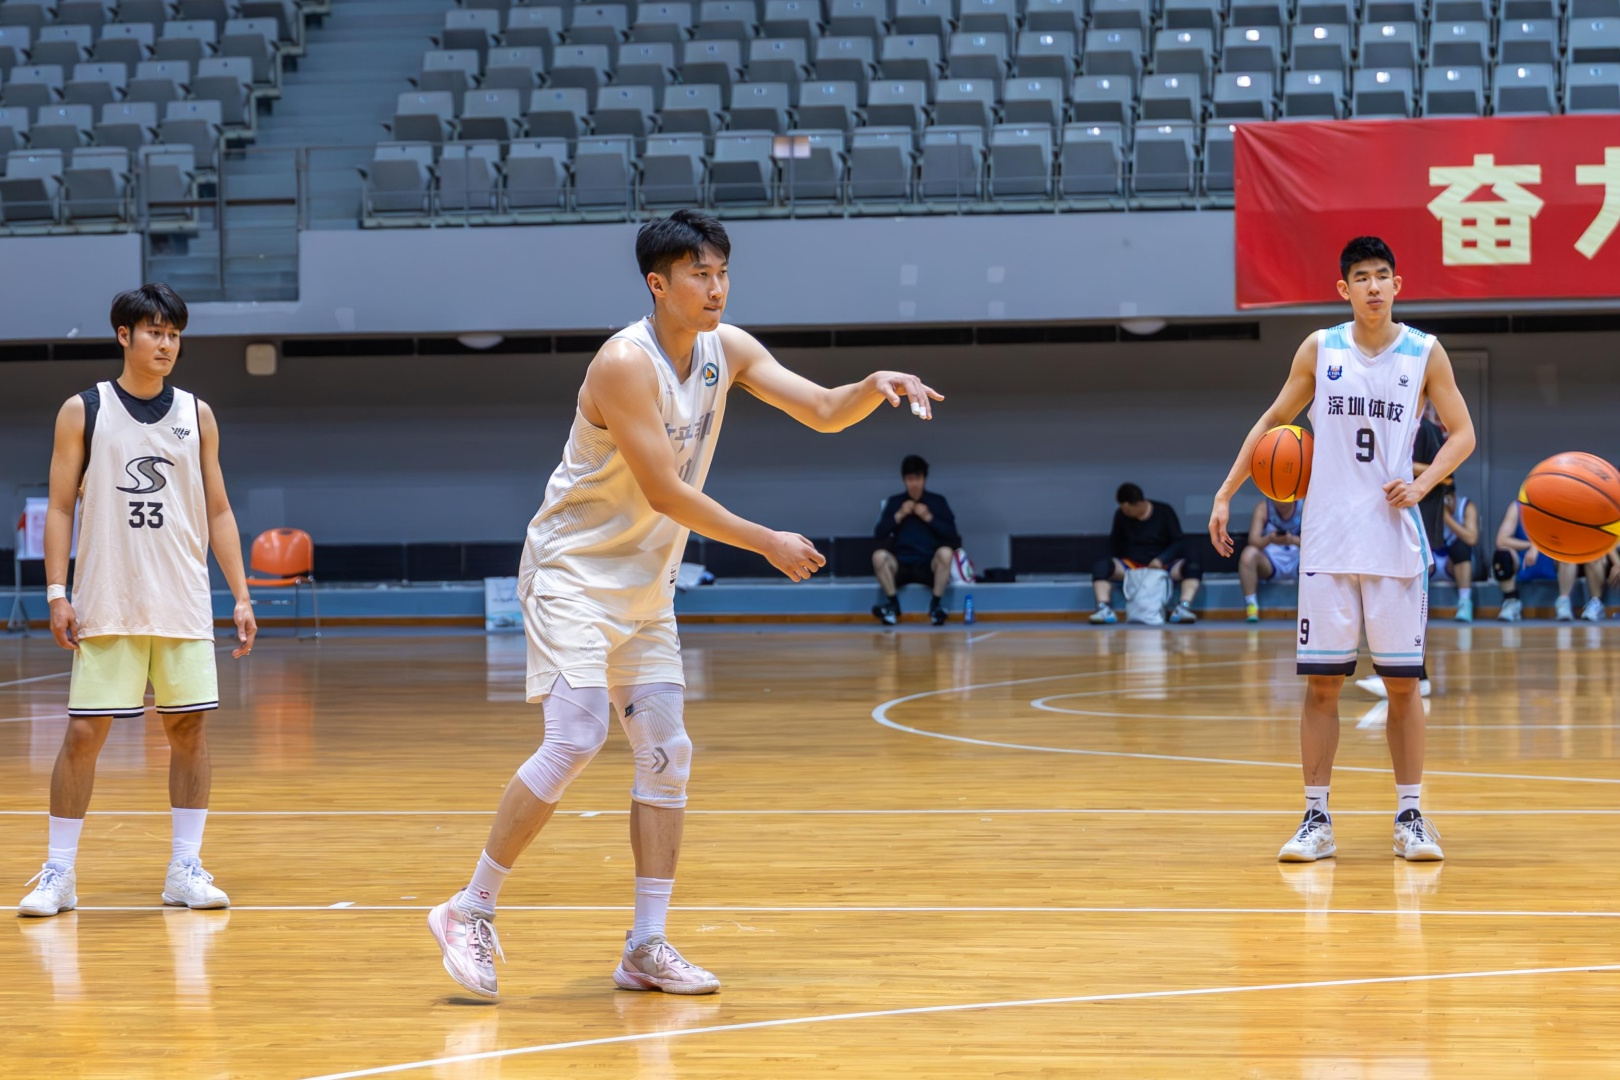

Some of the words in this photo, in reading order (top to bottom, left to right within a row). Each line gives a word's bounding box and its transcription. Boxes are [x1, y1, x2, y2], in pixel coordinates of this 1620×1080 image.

[1328, 395, 1405, 423] 深圳体校
[1356, 428, 1375, 463] 9
[128, 501, 164, 529] 33
[1299, 618, 1310, 645] 9
